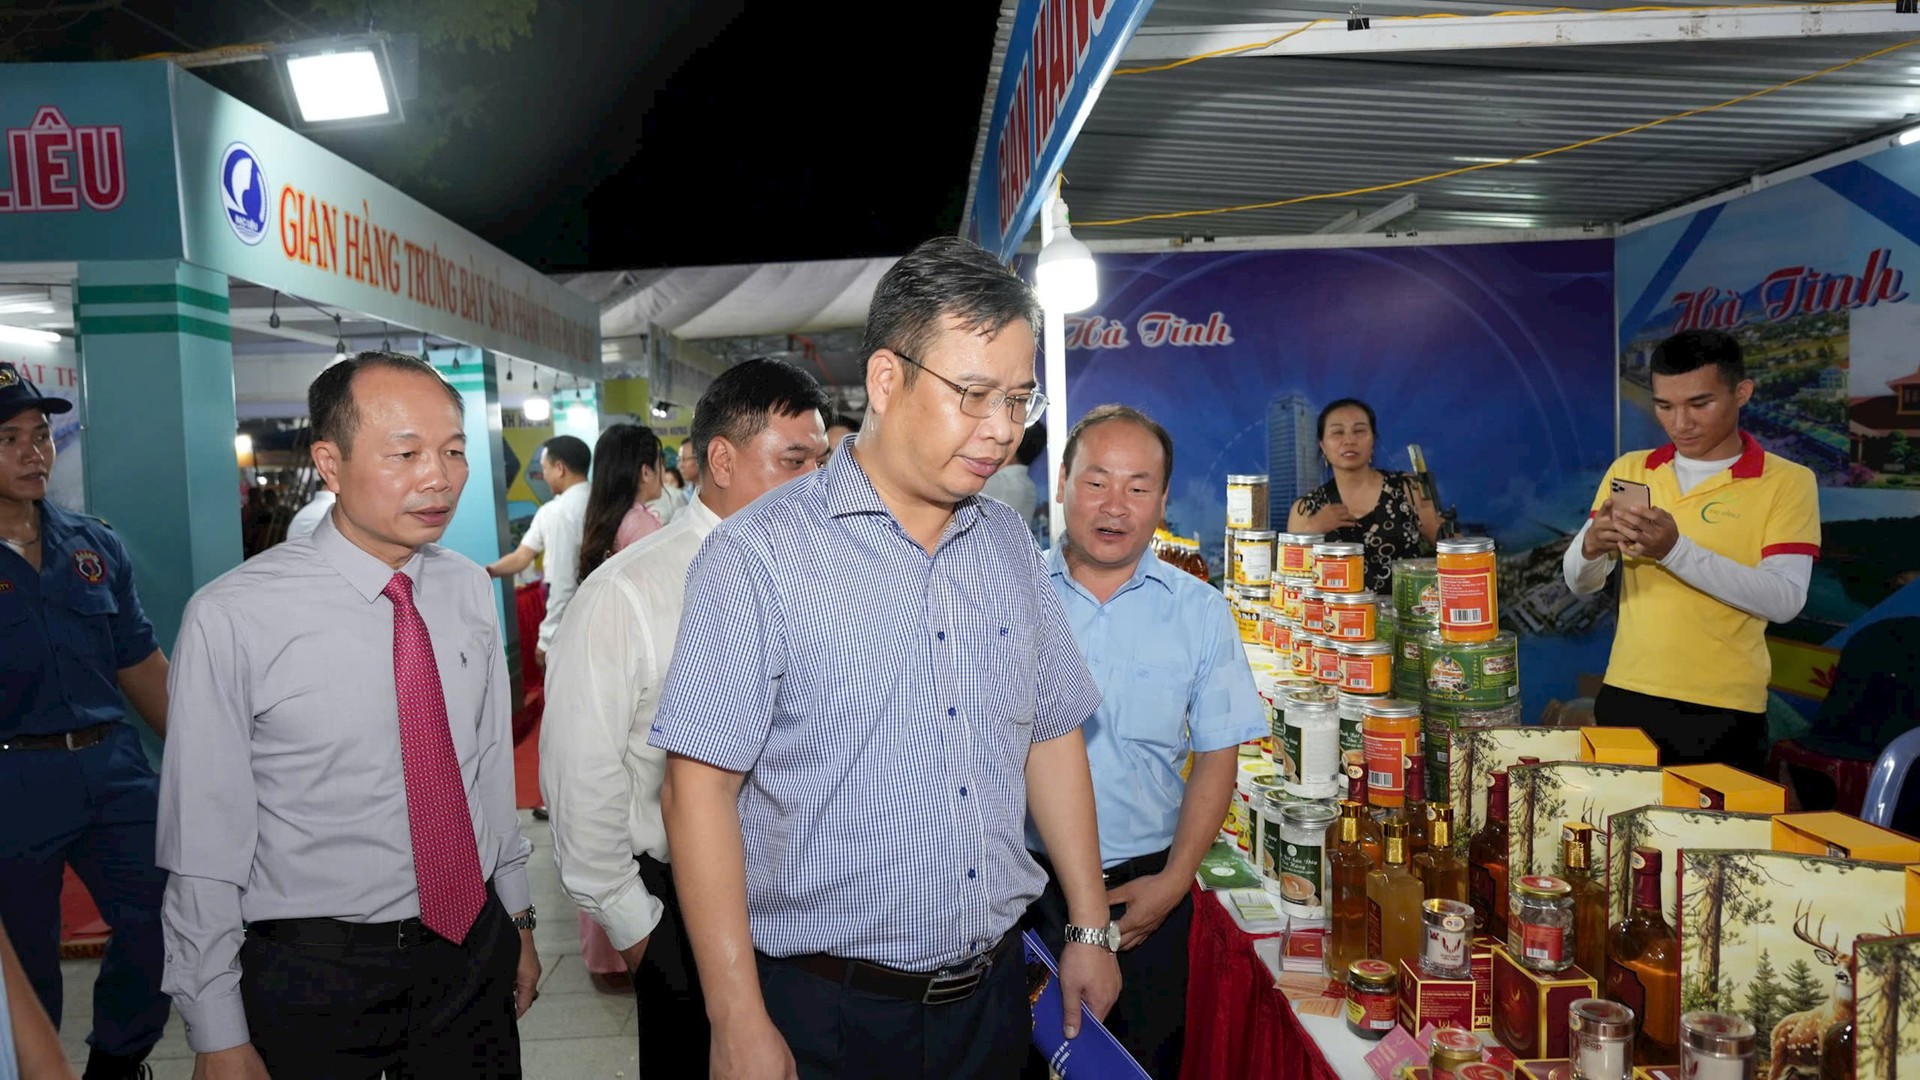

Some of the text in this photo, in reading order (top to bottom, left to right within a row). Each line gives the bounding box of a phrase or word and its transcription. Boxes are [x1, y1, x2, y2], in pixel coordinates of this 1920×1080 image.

[998, 50, 1032, 241] GIAN
[279, 183, 338, 273] GIAN
[344, 199, 401, 296] HÀNG
[460, 254, 486, 326] BÀY
[1672, 248, 1909, 333] Hà Tĩnh
[1065, 311, 1234, 349] Hà Tĩnh
